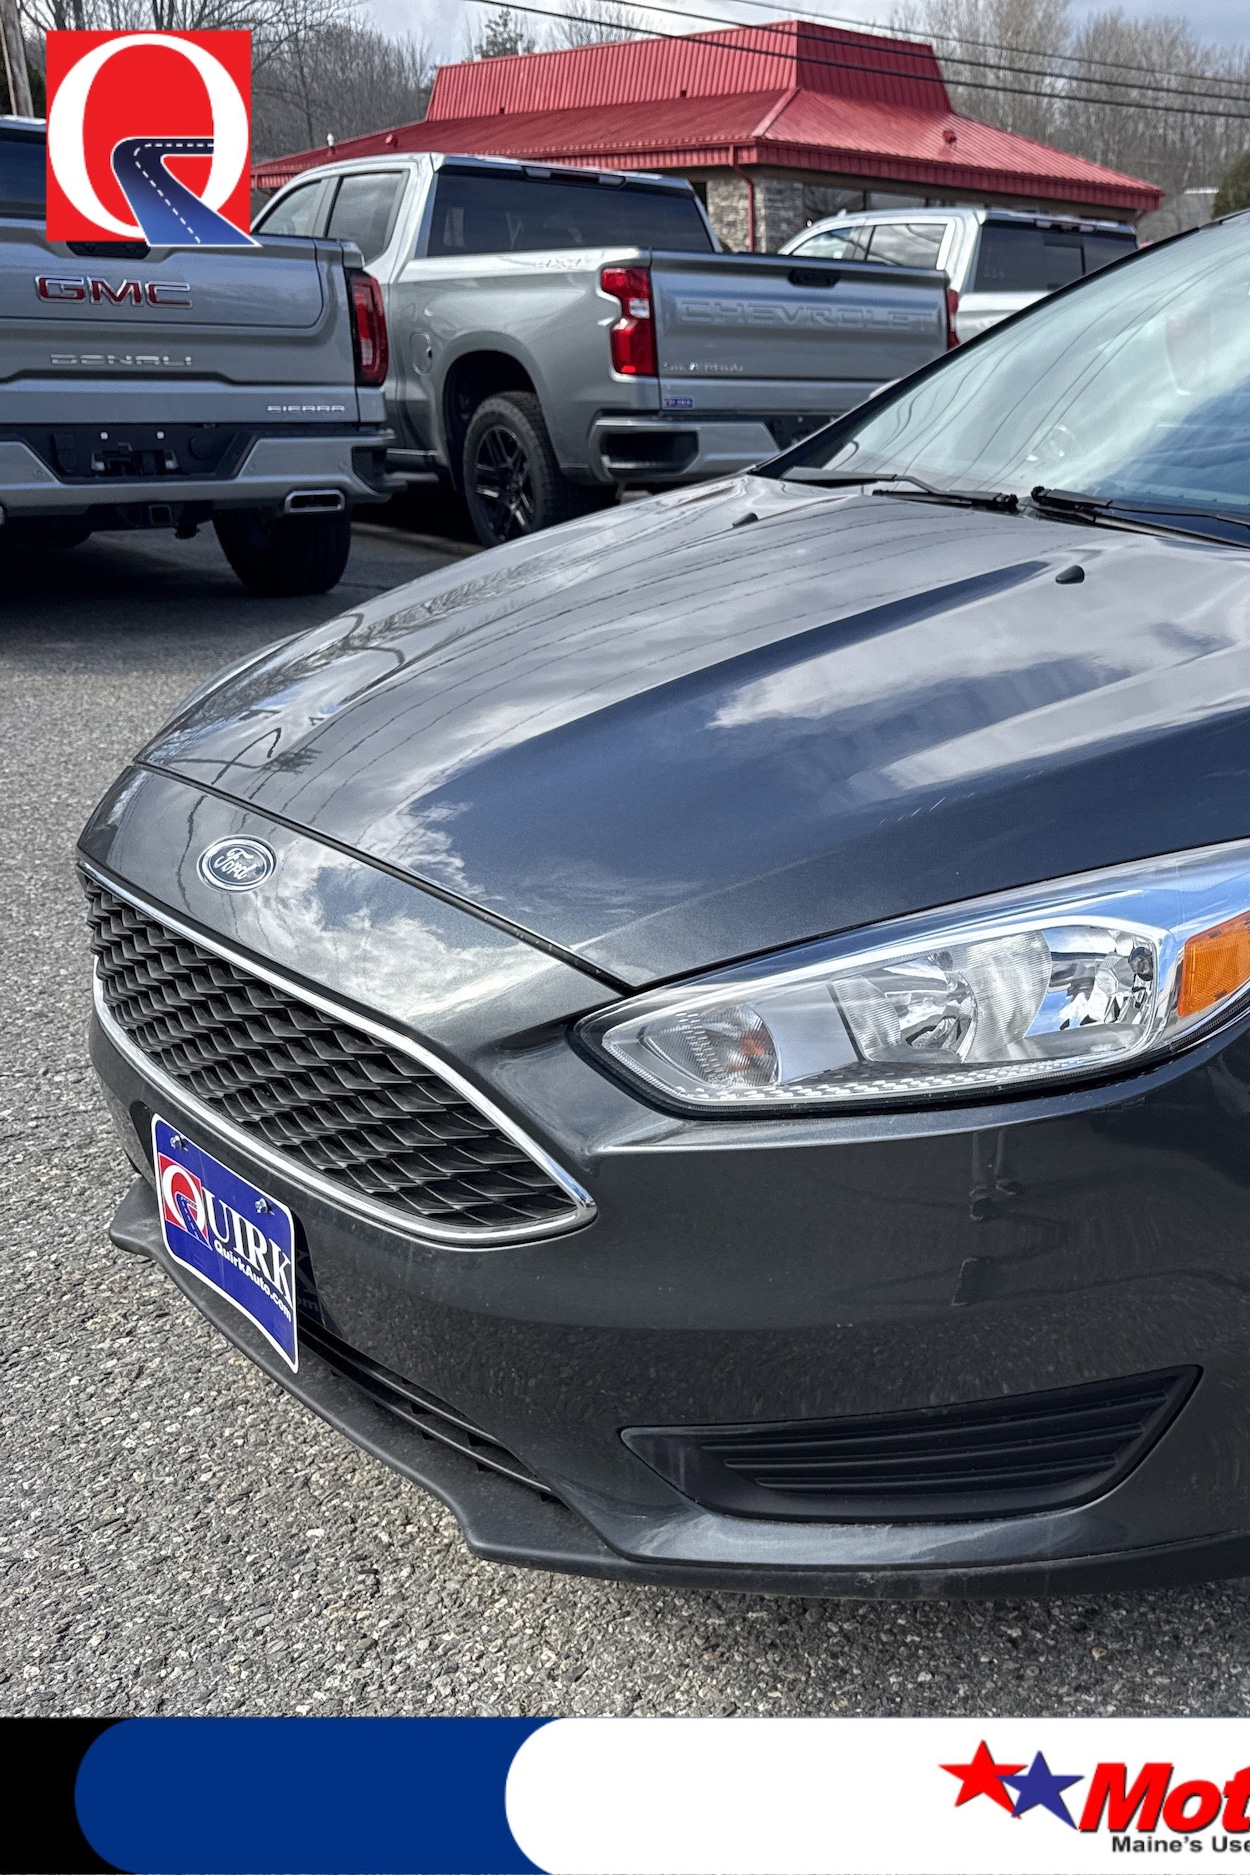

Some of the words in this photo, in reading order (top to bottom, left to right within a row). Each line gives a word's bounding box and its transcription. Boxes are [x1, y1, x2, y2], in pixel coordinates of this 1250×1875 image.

[35, 274, 193, 309] GMC
[680, 300, 934, 331] CHEVROLET
[51, 354, 192, 366] DENALI
[213, 847, 258, 880] Ford
[161, 1164, 293, 1309] QUIRK
[213, 1239, 292, 1323] QuirkAuto.com
